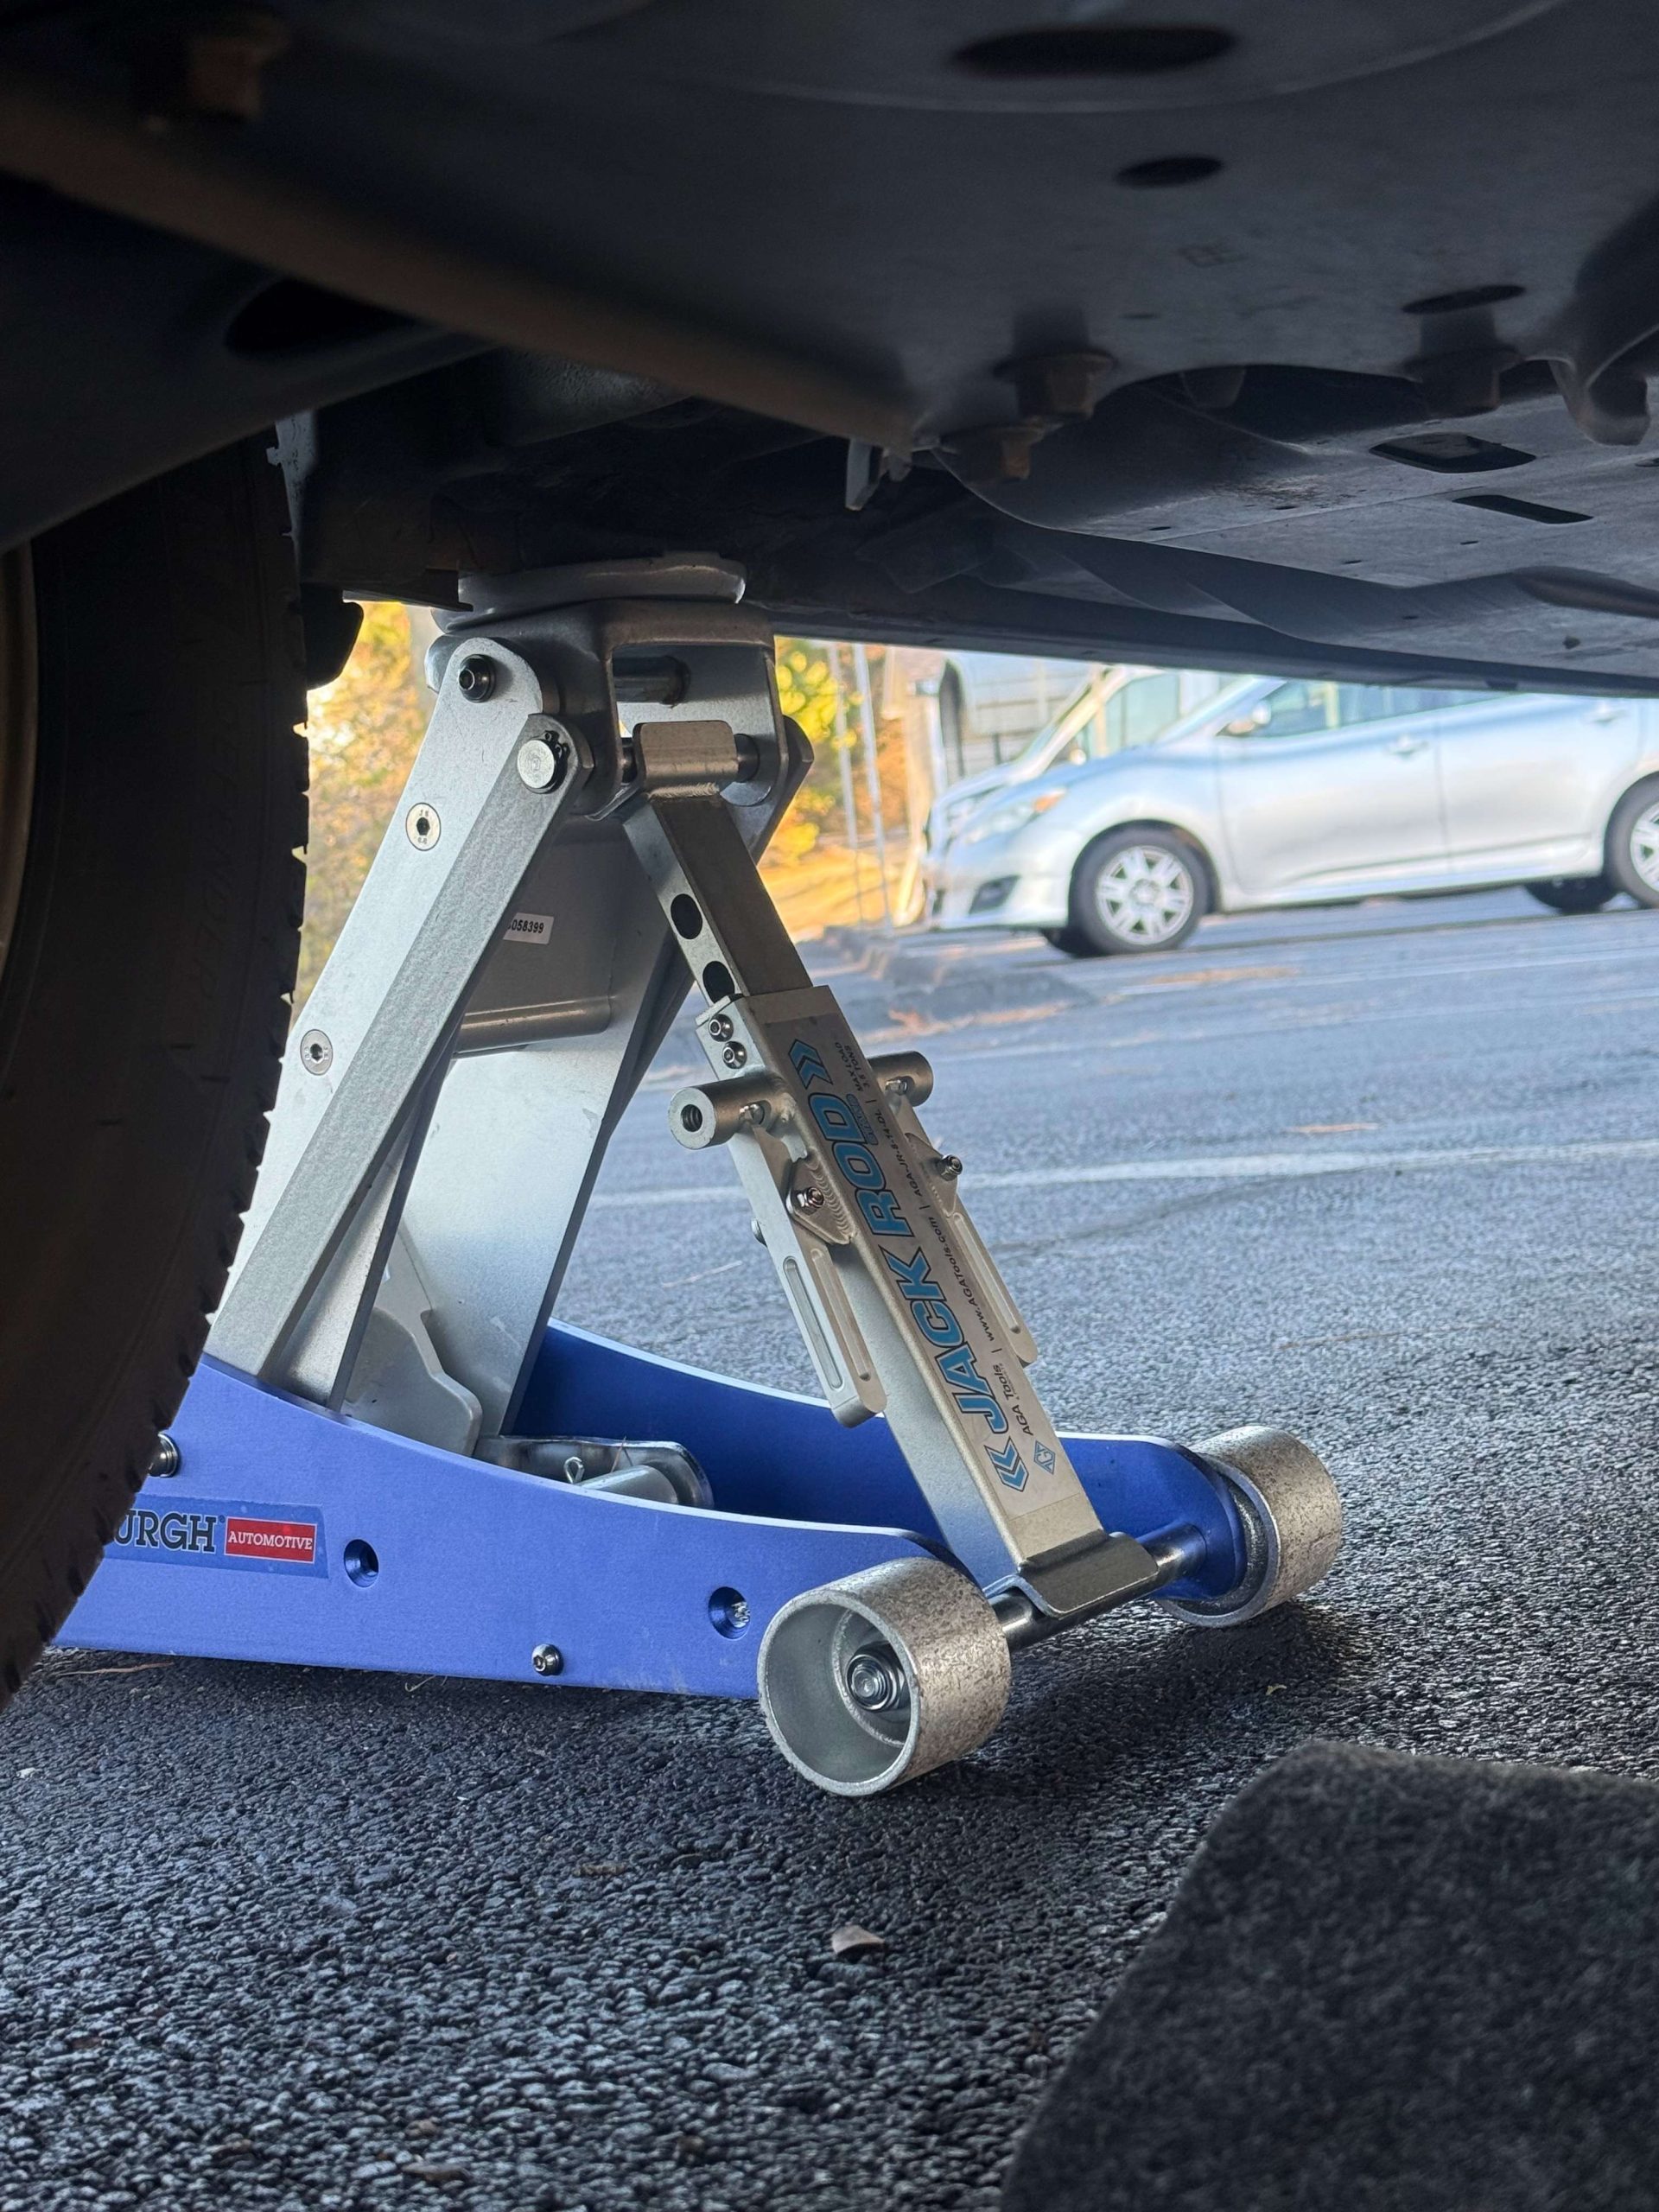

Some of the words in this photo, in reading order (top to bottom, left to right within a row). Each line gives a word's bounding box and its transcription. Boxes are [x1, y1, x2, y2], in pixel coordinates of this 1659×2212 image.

[508, 919, 544, 934] 058399
[835, 1042, 852, 1068] LOAD
[844, 1045, 862, 1071] TONS
[808, 1093, 915, 1238] ROD
[928, 1217, 995, 1342] www.AGATools.com
[878, 1244, 1009, 1435] JACK
[993, 1364, 1014, 1401] Tools
[1012, 1404, 1034, 1436] AGA
[227, 1530, 314, 1550] AUTOMOTIVE
